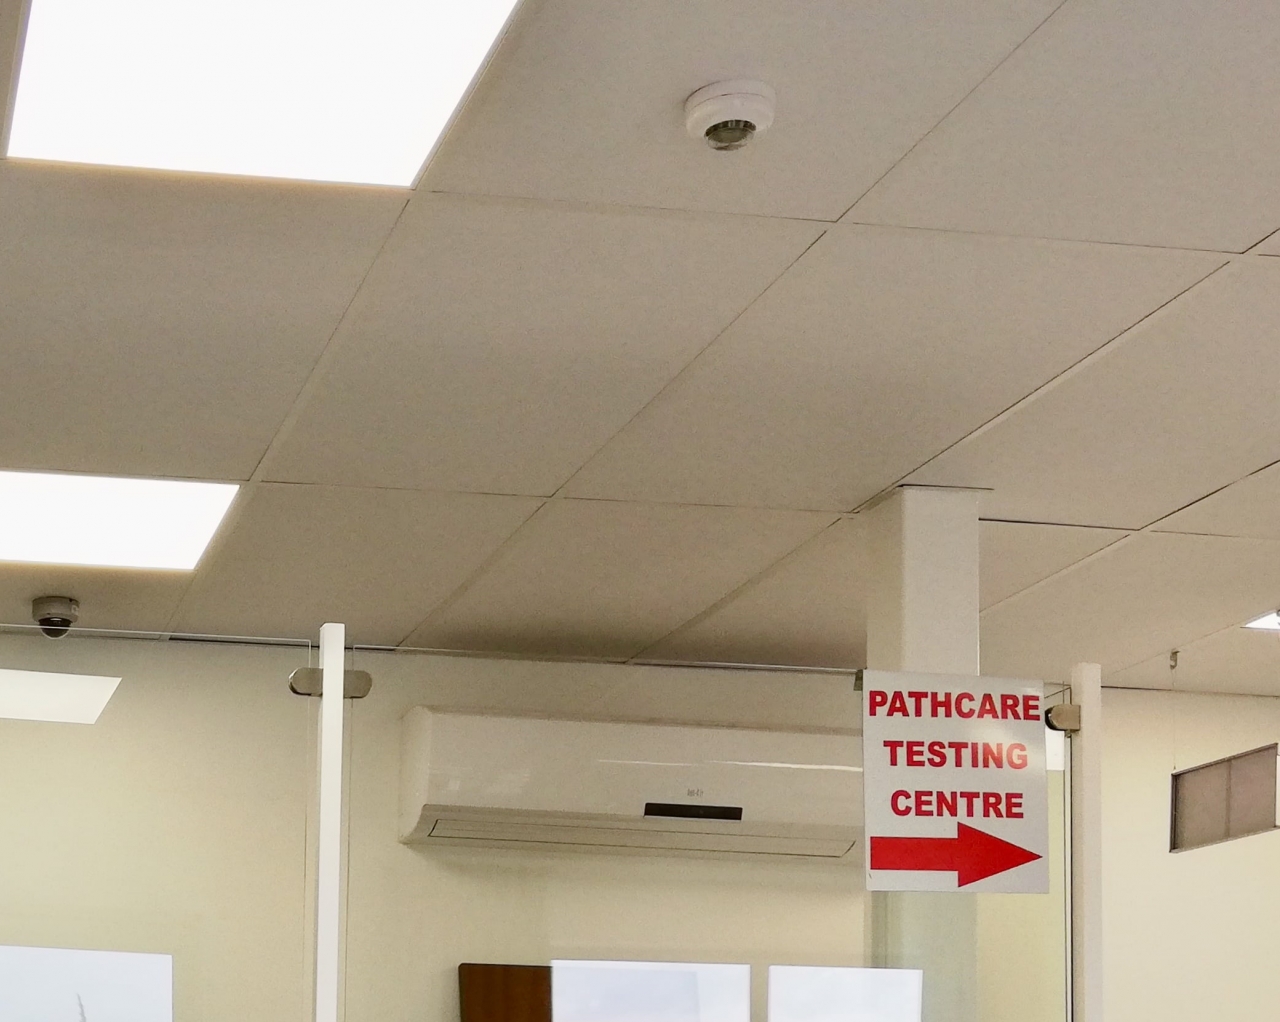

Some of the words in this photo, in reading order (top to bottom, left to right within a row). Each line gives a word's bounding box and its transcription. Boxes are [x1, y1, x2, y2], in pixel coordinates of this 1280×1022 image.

[869, 690, 1041, 721] PATHCARE
[883, 740, 1028, 769] TESTING
[890, 790, 1024, 819] CENTRE
